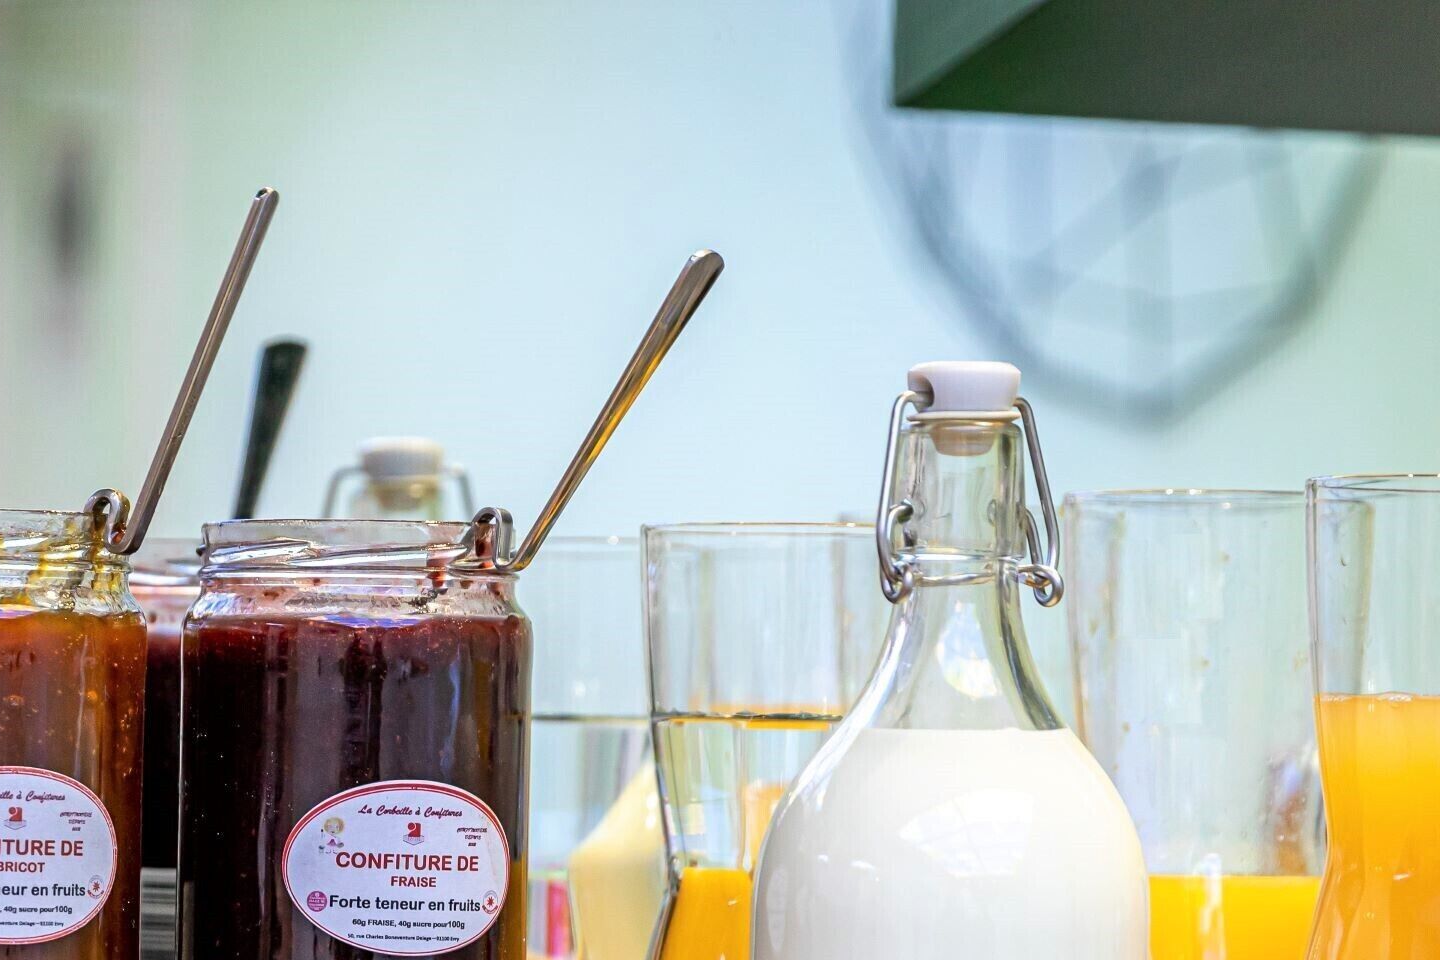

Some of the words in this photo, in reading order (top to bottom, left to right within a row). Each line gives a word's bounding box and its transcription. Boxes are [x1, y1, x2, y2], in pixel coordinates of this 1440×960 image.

[358, 804, 372, 814] La
[376, 805, 412, 816] Corbeille
[414, 806, 421, 816] à
[424, 806, 463, 819] Confitures
[61, 840, 84, 856] DE
[336, 852, 452, 871] CONFITURE
[457, 855, 479, 872] DE
[390, 876, 437, 888] FRAISE
[31, 885, 49, 896] en
[52, 883, 86, 897] fruits
[3, 905, 17, 914] 40g
[18, 906, 38, 914] sucre
[329, 895, 371, 909] Forte
[376, 896, 424, 911] teneur
[428, 901, 445, 911] en
[448, 898, 481, 912] fruits
[352, 918, 366, 927] 60g
[367, 918, 397, 928] FRAISE,
[398, 919, 412, 928] 40g
